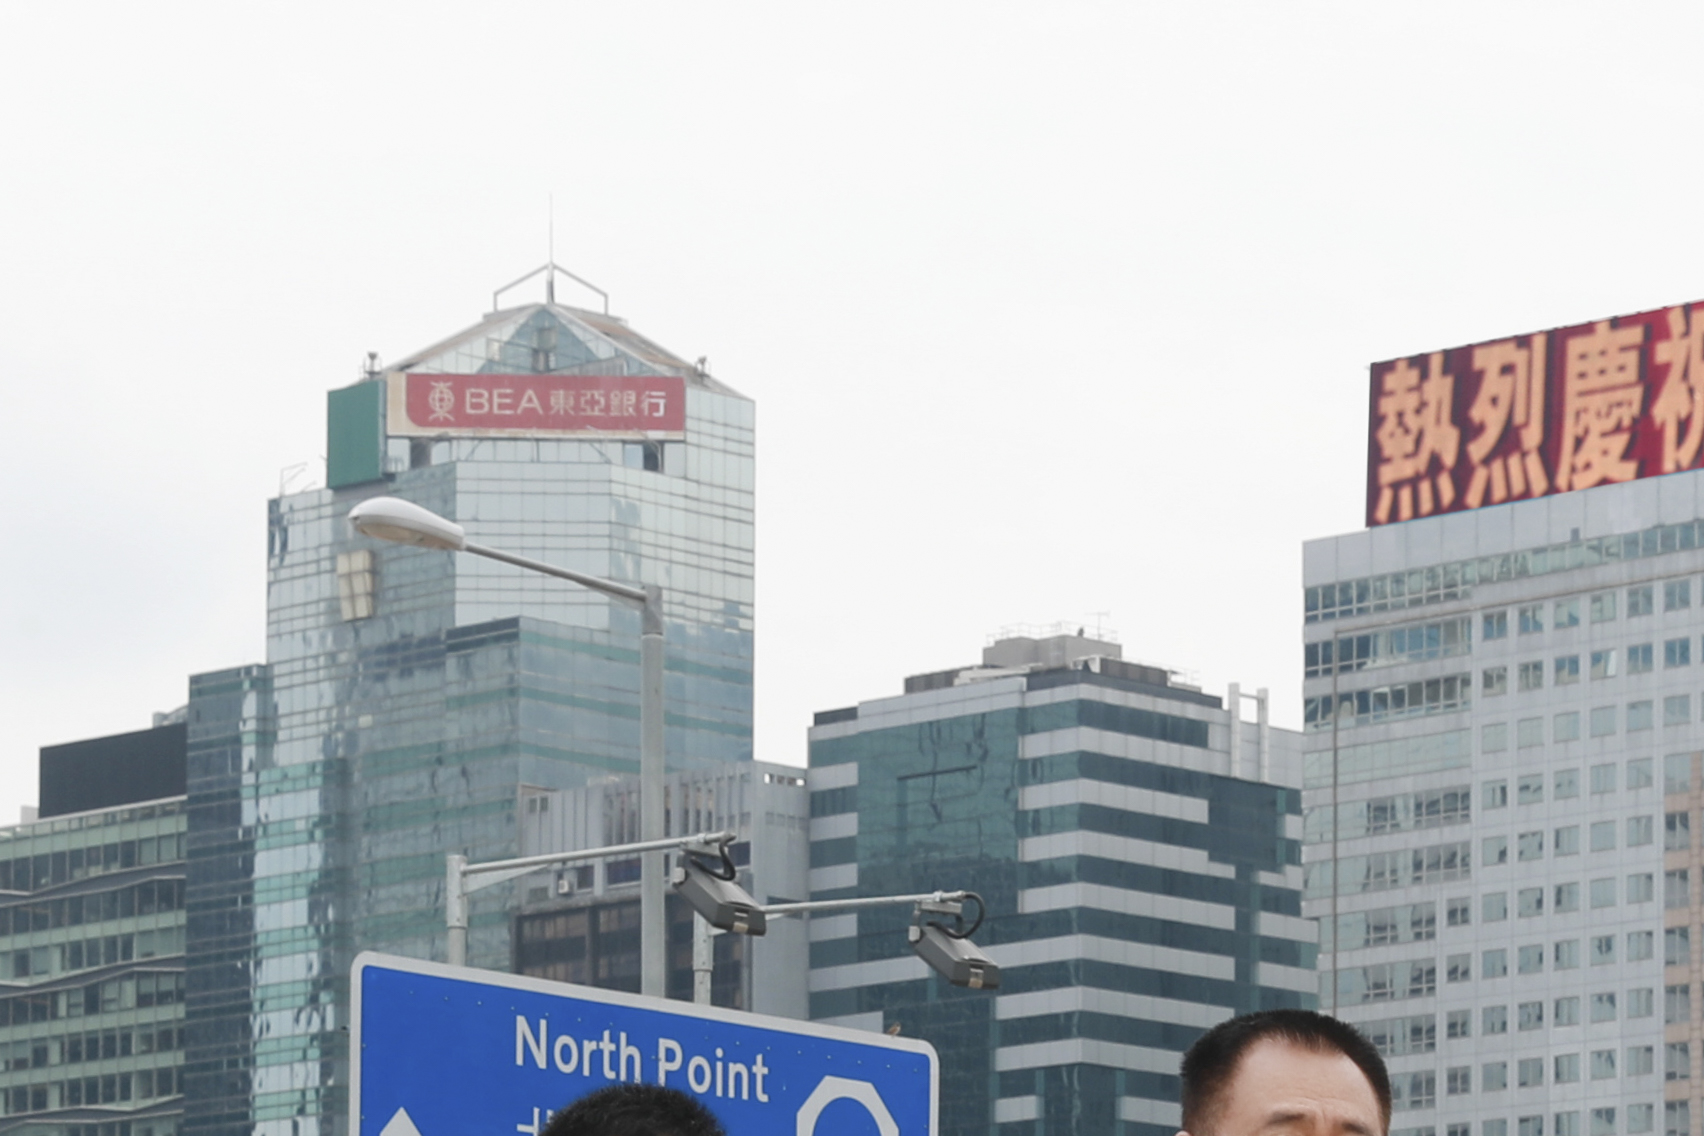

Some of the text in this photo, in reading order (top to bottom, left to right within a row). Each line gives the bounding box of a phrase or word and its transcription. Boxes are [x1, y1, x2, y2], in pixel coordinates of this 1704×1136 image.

[464, 387, 667, 418] BEA 東亞銀行
[515, 1014, 769, 1103] North Point
